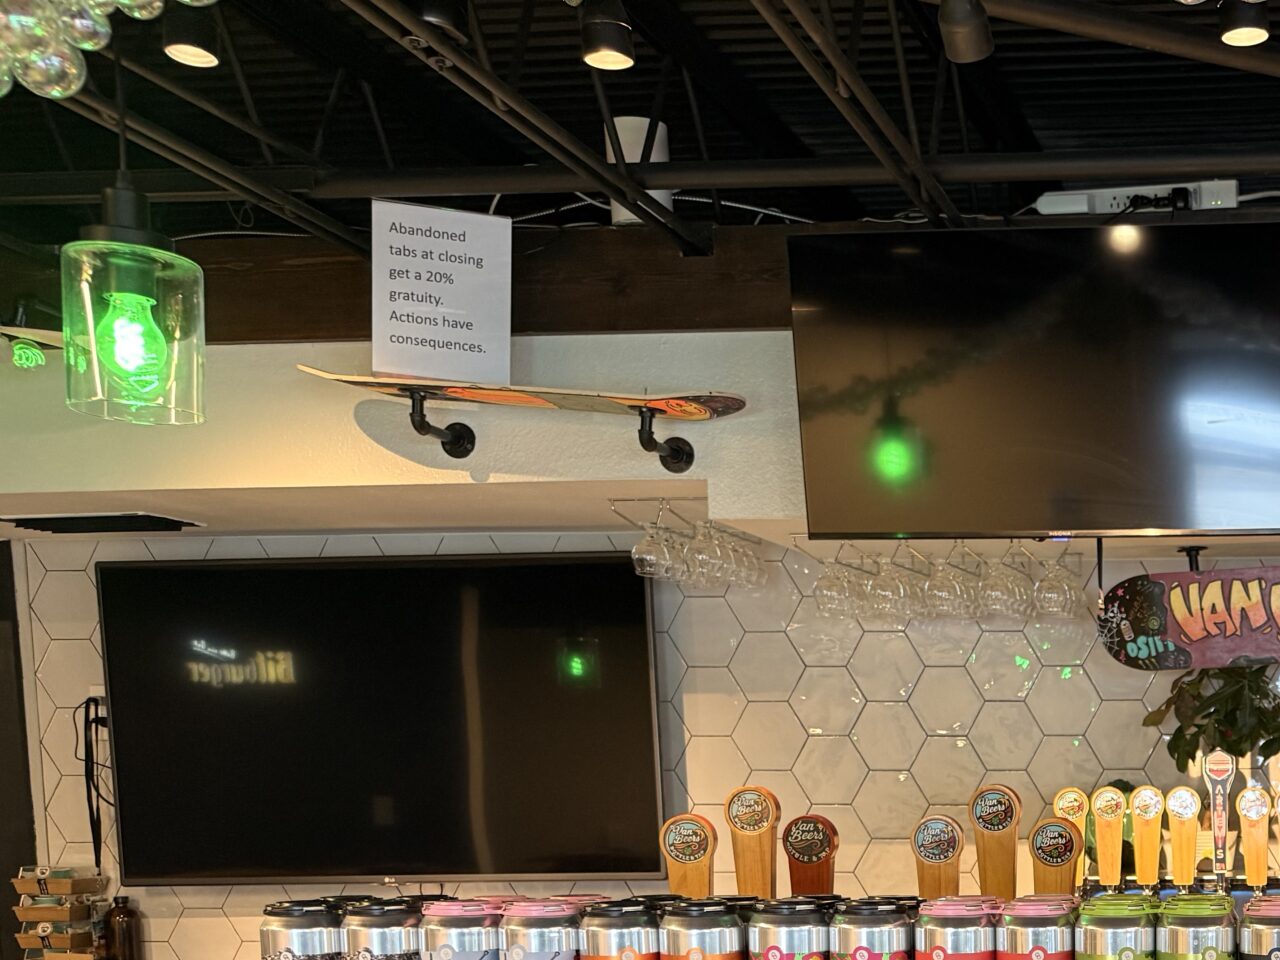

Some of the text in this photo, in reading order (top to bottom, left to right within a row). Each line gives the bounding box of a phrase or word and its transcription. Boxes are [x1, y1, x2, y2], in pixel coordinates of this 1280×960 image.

[389, 222, 466, 242] Abandoned
[389, 245, 484, 268] tabs at closing
[389, 268, 454, 285] get a 20%
[389, 290, 444, 306] gratuity.
[389, 310, 473, 330] Actions have
[390, 334, 486, 354] consequences.
[1169, 579, 1268, 643] VAN
